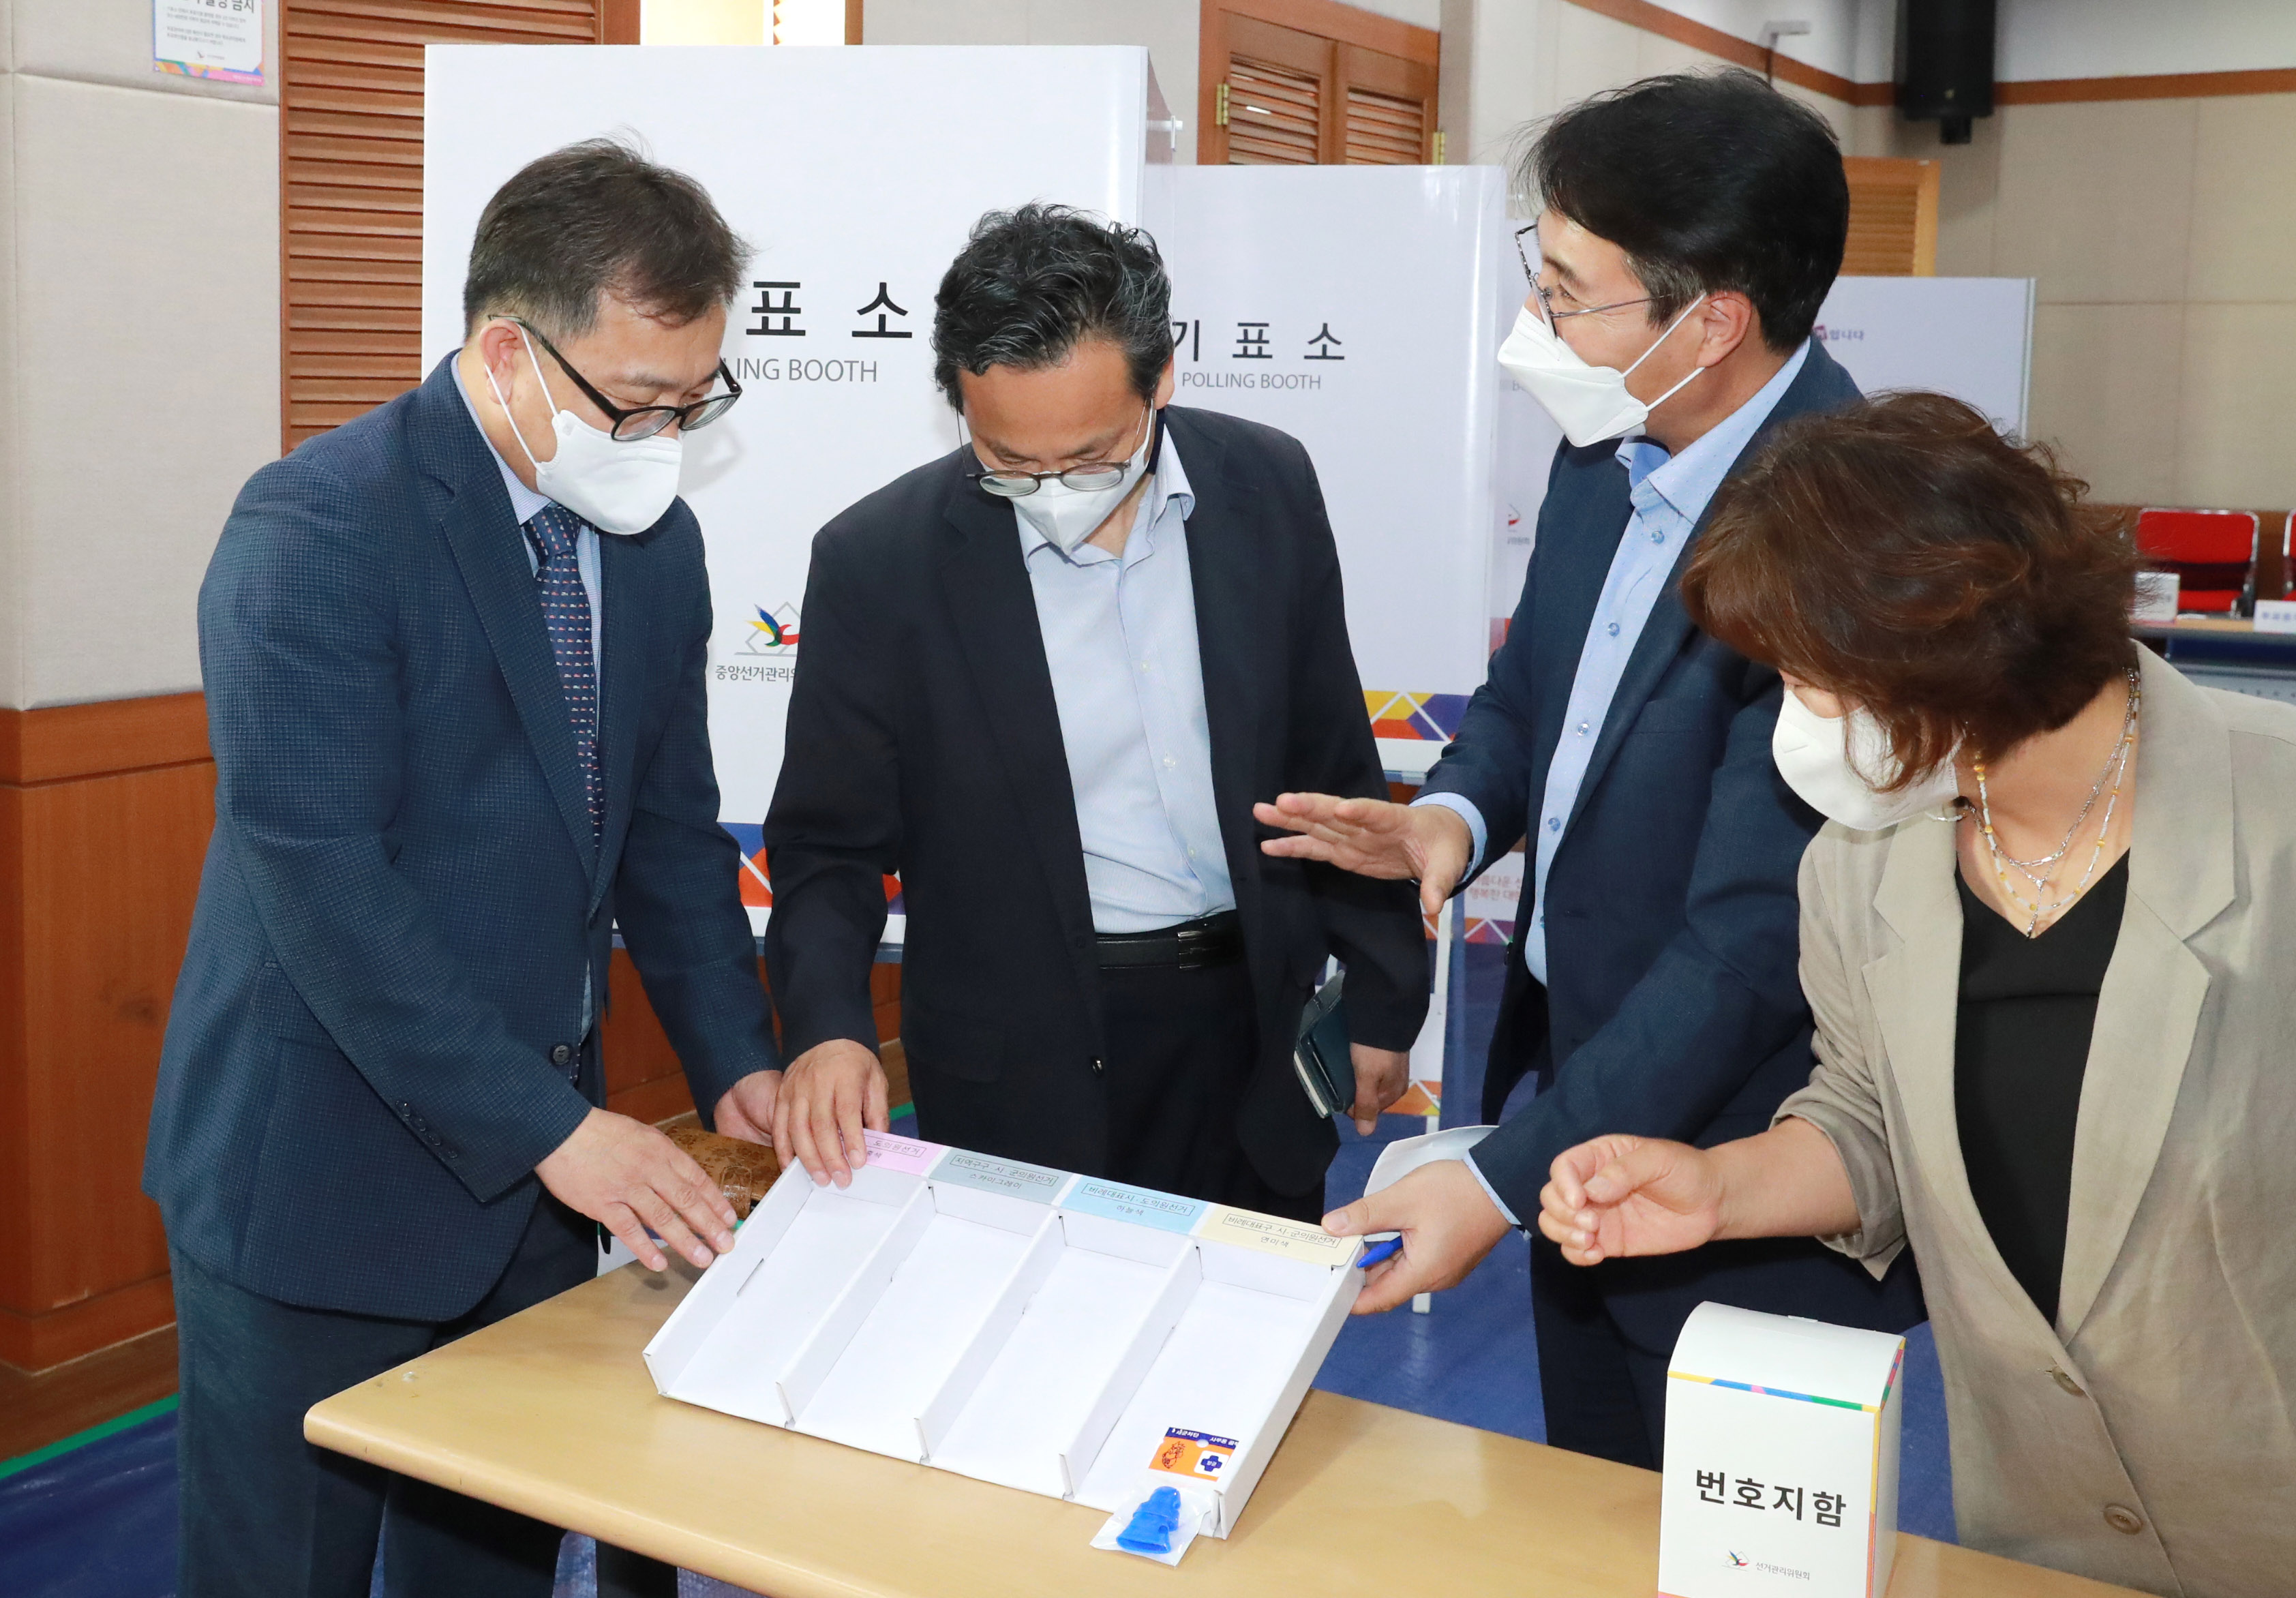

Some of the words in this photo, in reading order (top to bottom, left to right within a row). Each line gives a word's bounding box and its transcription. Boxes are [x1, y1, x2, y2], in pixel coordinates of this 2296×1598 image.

[723, 357, 780, 380] ING
[789, 359, 877, 382] BOOTH
[1182, 372, 1255, 389] POLLING
[1260, 374, 1321, 390] BOOTH
[1696, 1469, 1847, 1528] 번호지함
[1755, 1562, 1811, 1581] 선거관리위원회
